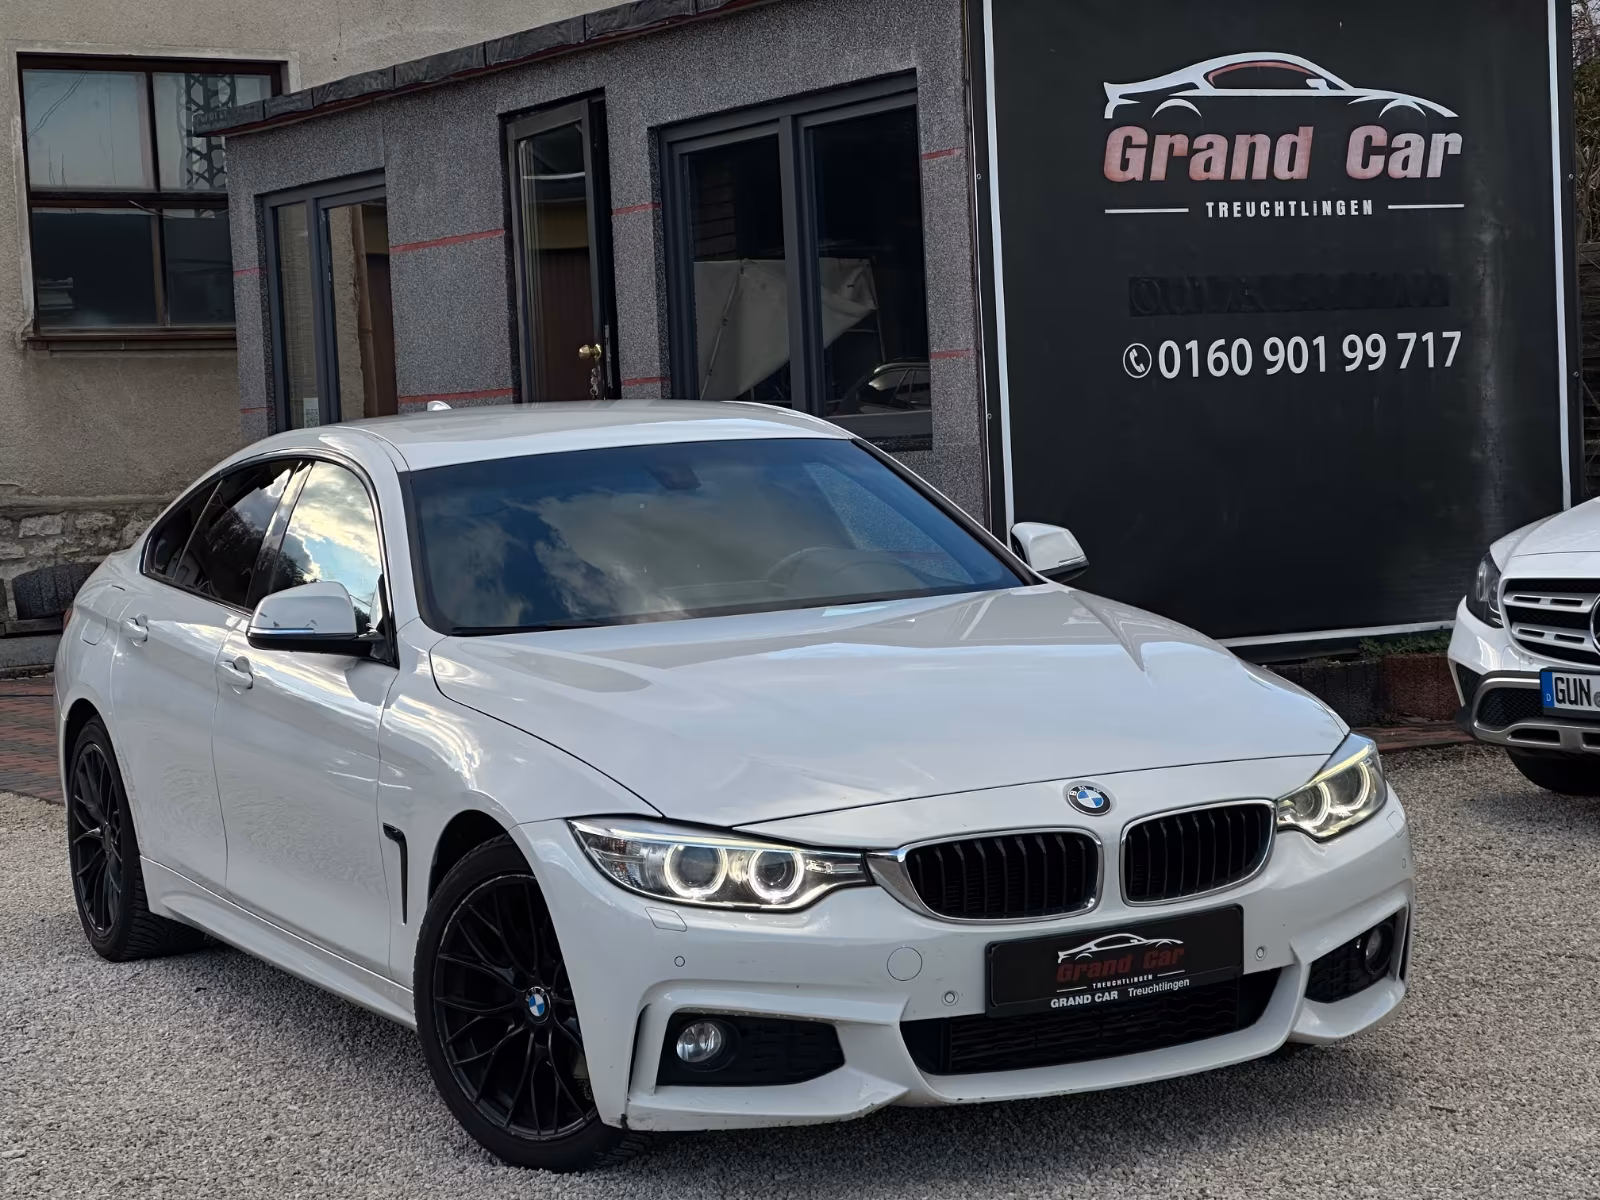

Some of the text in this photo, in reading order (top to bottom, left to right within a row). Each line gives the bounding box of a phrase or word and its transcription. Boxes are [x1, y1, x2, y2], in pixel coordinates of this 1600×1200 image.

[1103, 124, 1463, 182] Grand Car
[1158, 331, 1462, 379] 0160 901 99 717
[1554, 676, 1592, 707] GUN
[1057, 947, 1185, 982] Grand Car
[1050, 978, 1190, 1009] GRAND CAR Treuchtlingen
